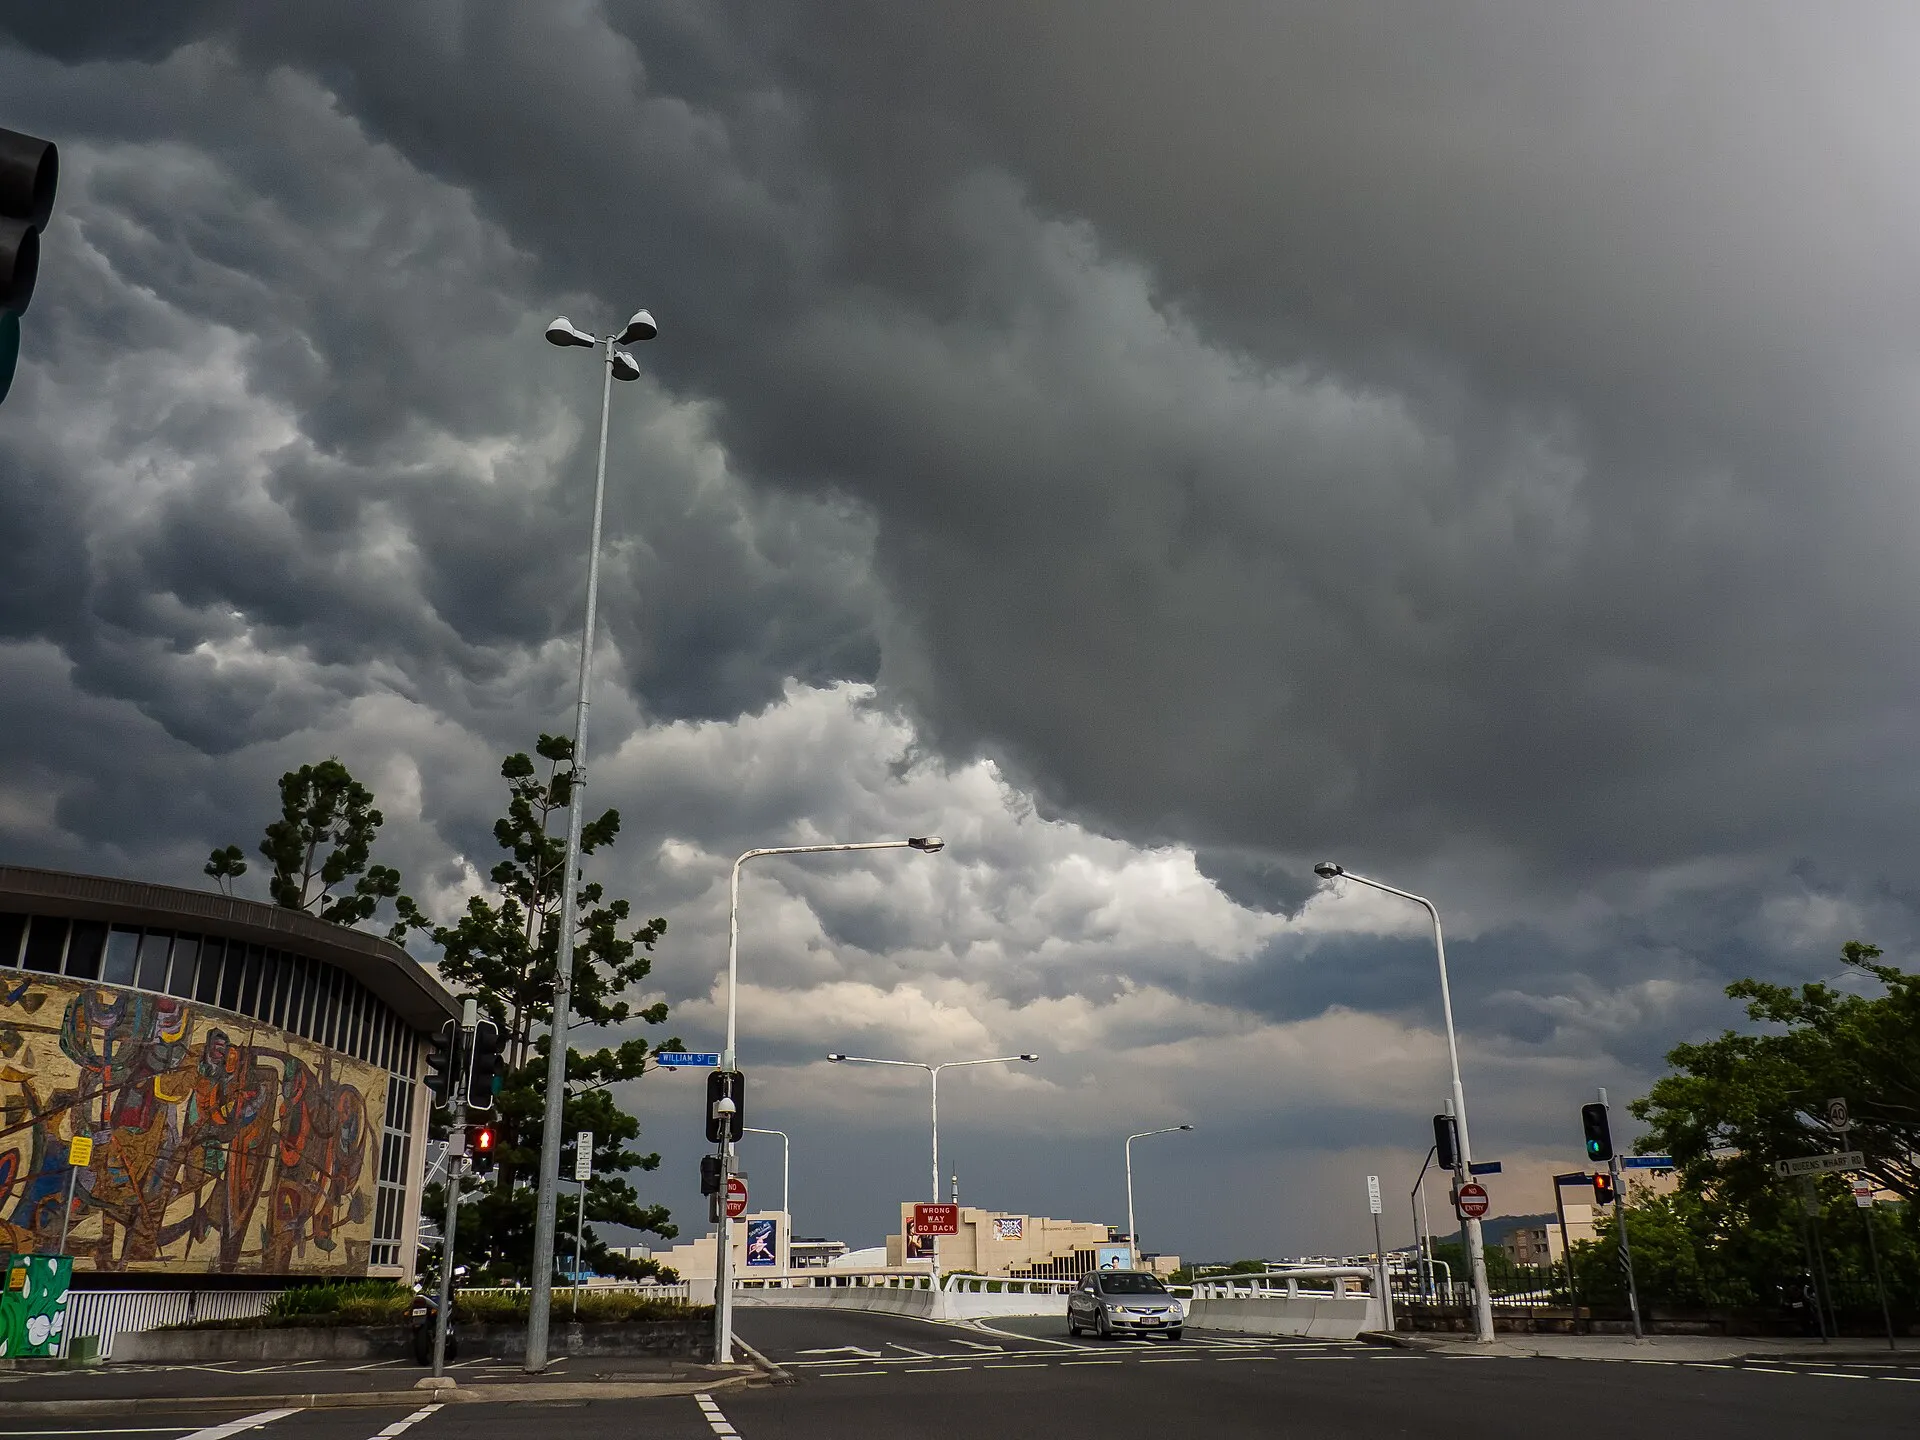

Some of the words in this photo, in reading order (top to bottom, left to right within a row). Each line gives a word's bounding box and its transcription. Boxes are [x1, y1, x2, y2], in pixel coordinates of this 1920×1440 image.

[663, 1054, 693, 1062] WILLIAM
[1832, 1108, 1845, 1120] 40
[1792, 1160, 1820, 1171] QUEENS
[1822, 1156, 1847, 1168] WHARF
[1851, 1155, 1861, 1165] RD
[728, 1183, 737, 1191] NO
[726, 1202, 742, 1210] NTRY
[1464, 1204, 1484, 1212] ENTRY
[1000, 1219, 1021, 1229] ROCK
